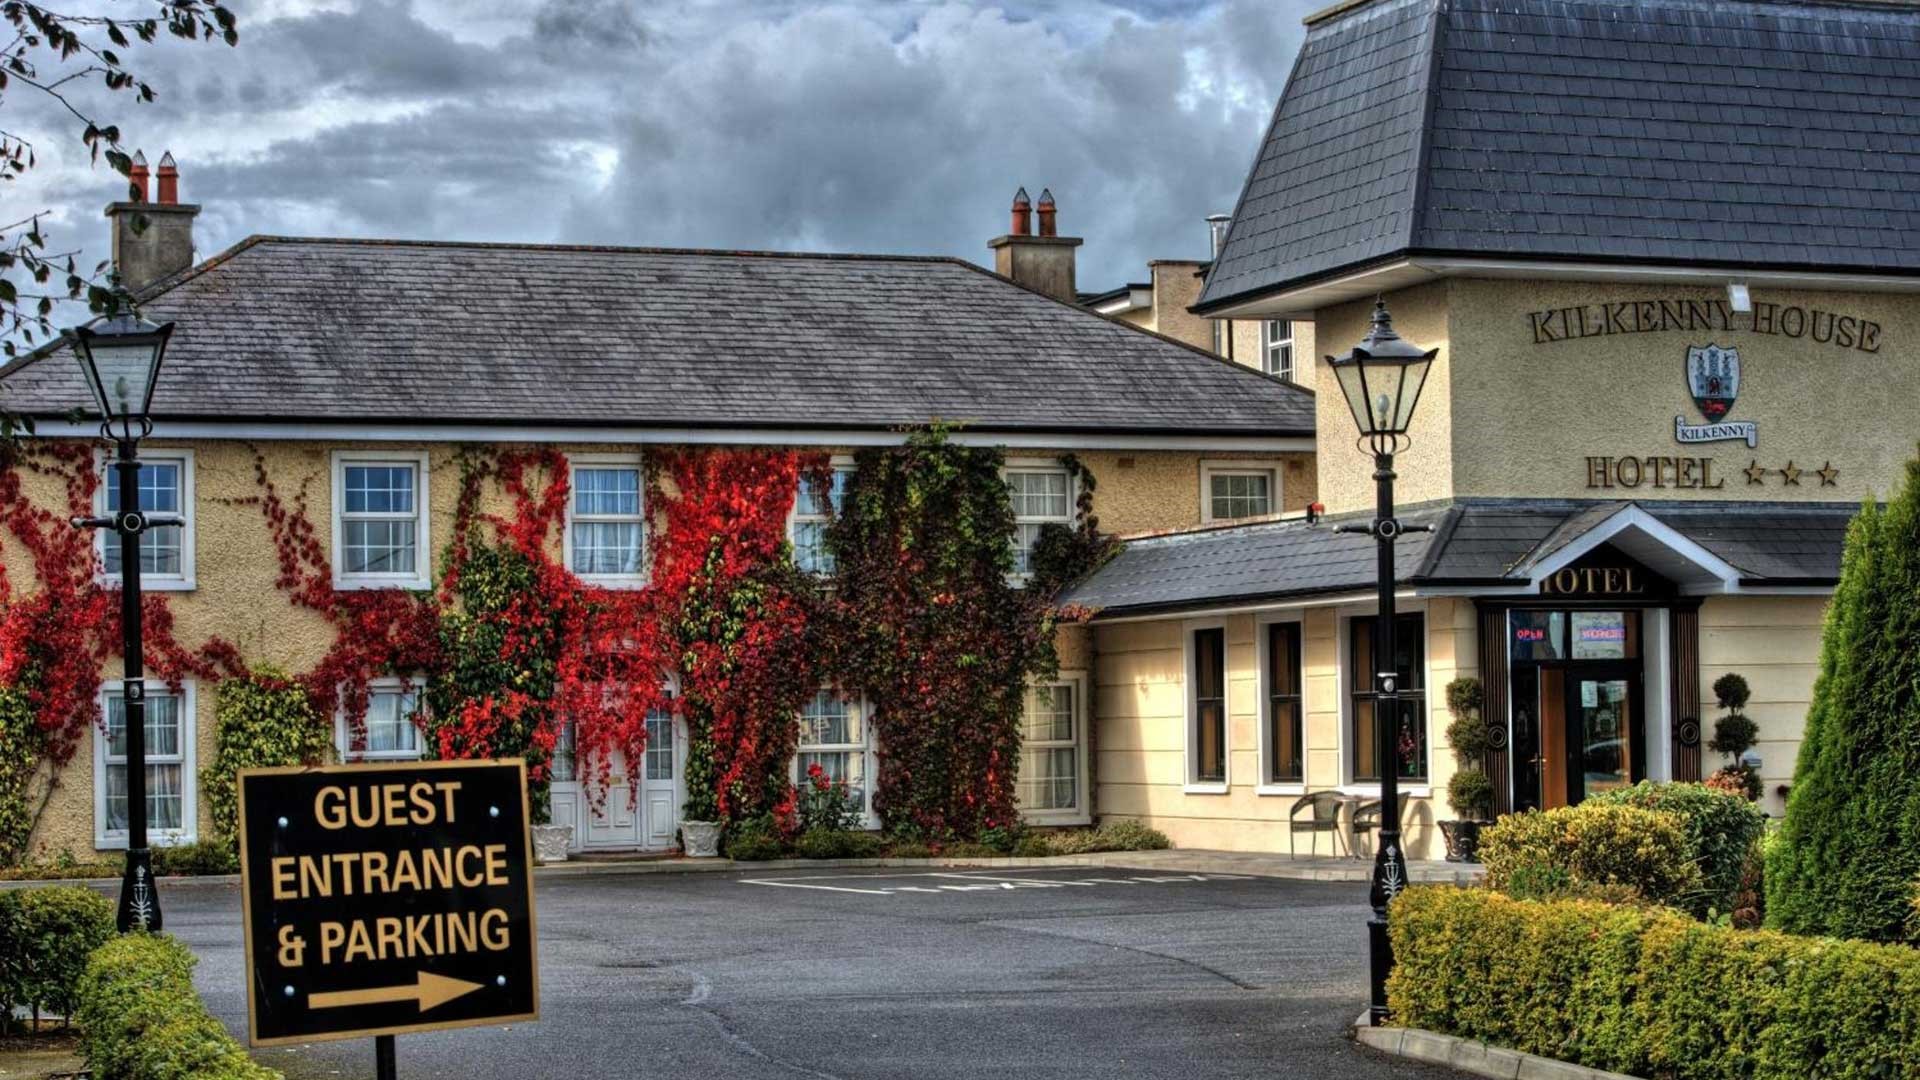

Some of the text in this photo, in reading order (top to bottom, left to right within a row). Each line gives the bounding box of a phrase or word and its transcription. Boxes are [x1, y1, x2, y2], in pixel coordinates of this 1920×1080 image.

[1529, 299, 1881, 353] KILKENNY HOUSE
[1681, 425, 1745, 440] KILKENNY
[1585, 455, 1724, 489] HOTEL
[1516, 628, 1544, 640] OPEN
[314, 781, 462, 830] GUEST
[271, 844, 509, 900] ENTRANCE
[277, 908, 510, 968] & PARKING
